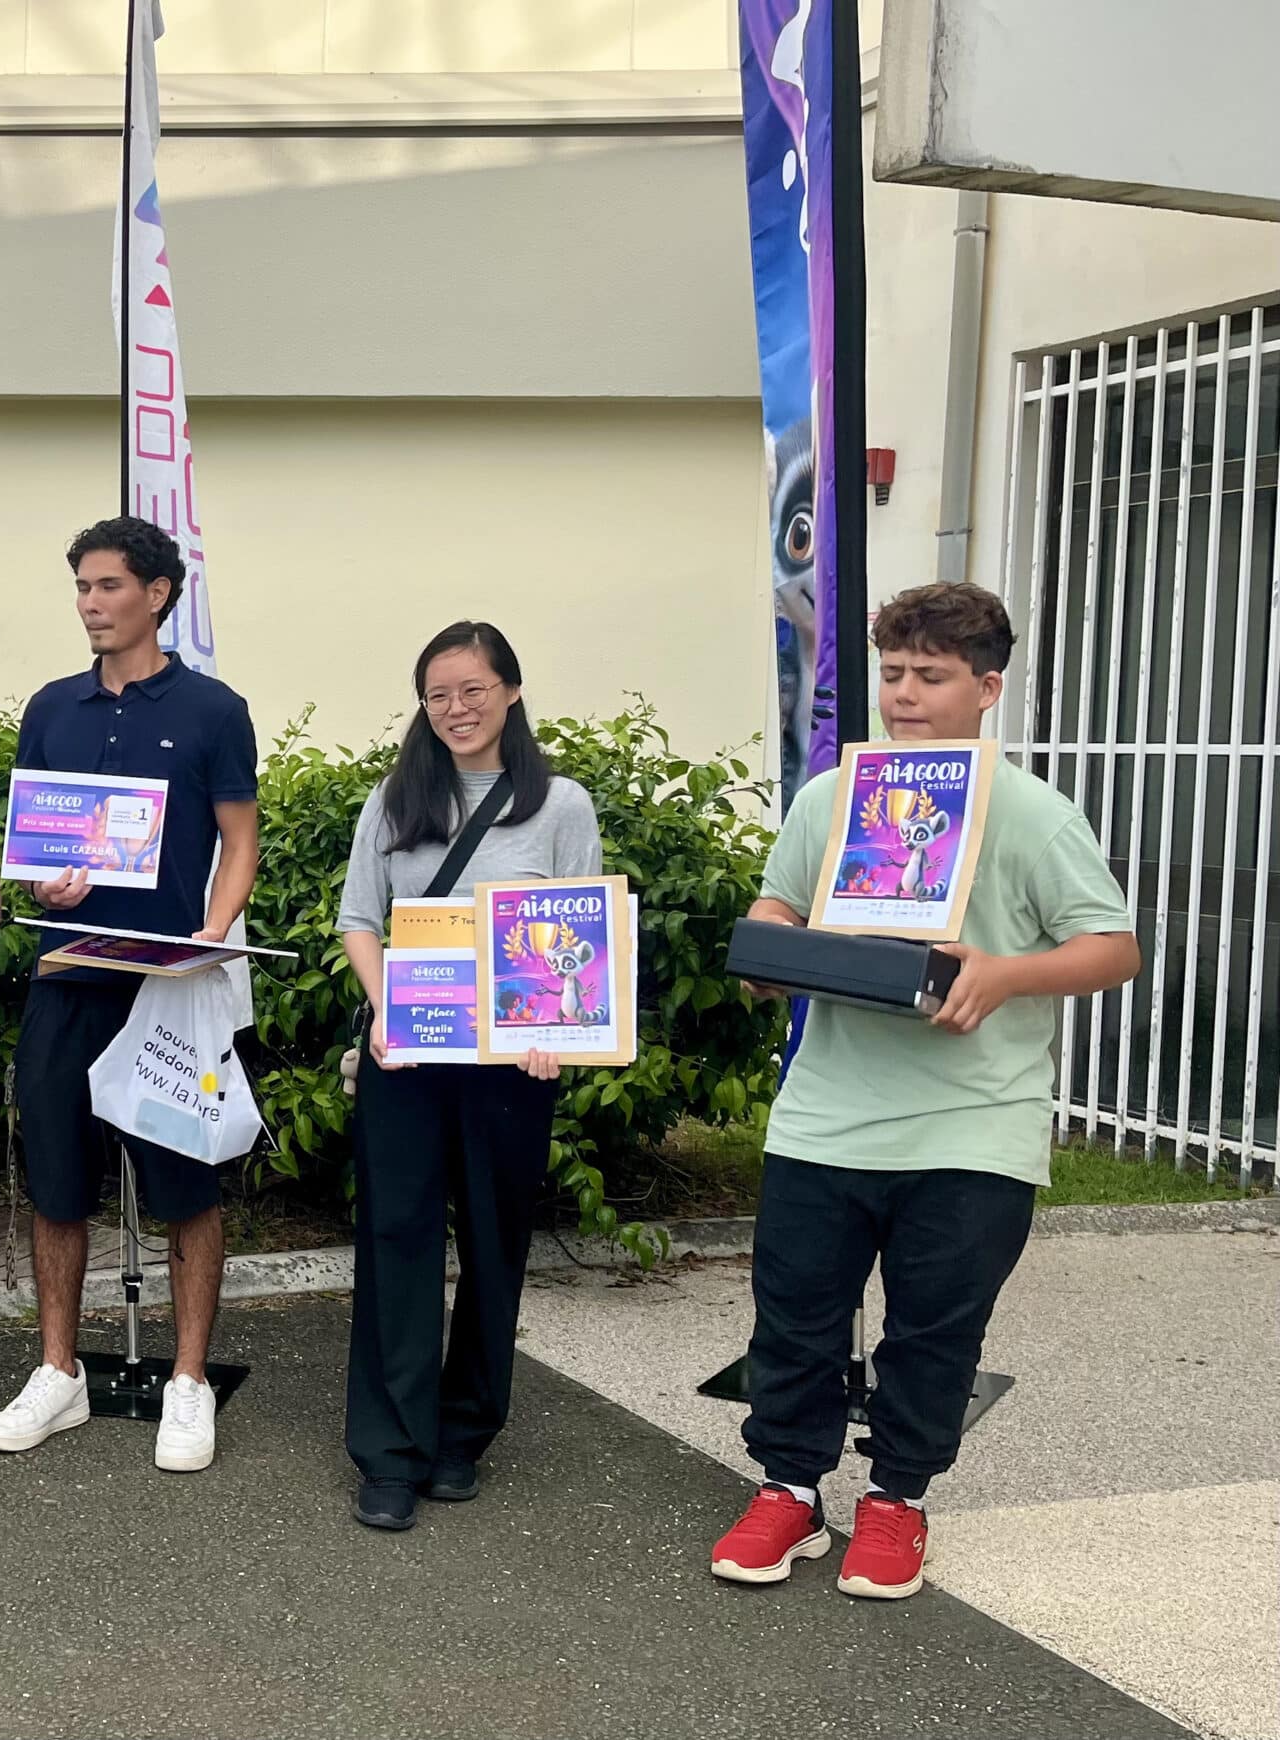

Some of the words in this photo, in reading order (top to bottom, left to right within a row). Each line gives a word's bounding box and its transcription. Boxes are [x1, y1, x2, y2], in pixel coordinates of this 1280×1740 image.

[877, 758, 966, 784] Ai4GOOD
[920, 781, 964, 790] Festival
[516, 895, 602, 918] Ai4GOOD
[560, 914, 602, 923] Festival
[155, 1024, 198, 1059] nouve
[144, 1041, 199, 1080] alédoni
